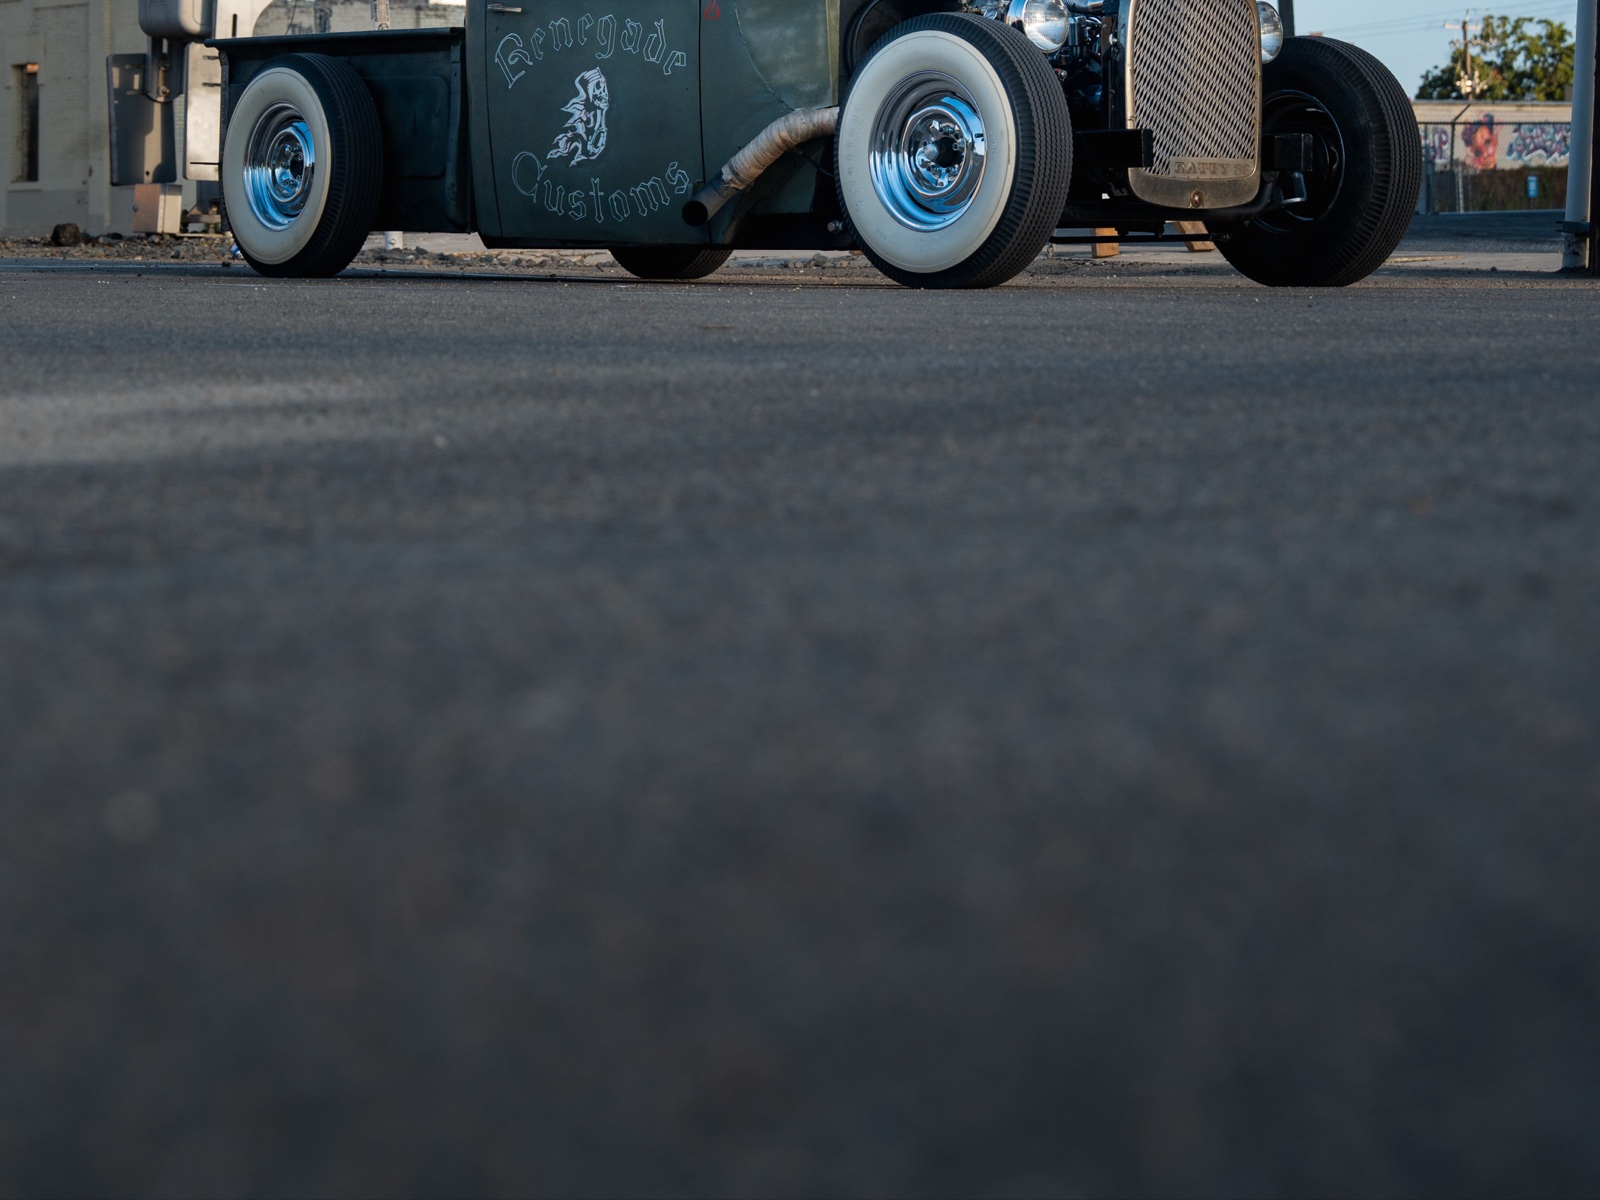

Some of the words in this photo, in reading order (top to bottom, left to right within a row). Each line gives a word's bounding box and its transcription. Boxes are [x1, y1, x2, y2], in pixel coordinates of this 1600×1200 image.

[494, 13, 687, 89] Renegade
[511, 151, 690, 224] Customs
[1174, 161, 1230, 176] RATTY
